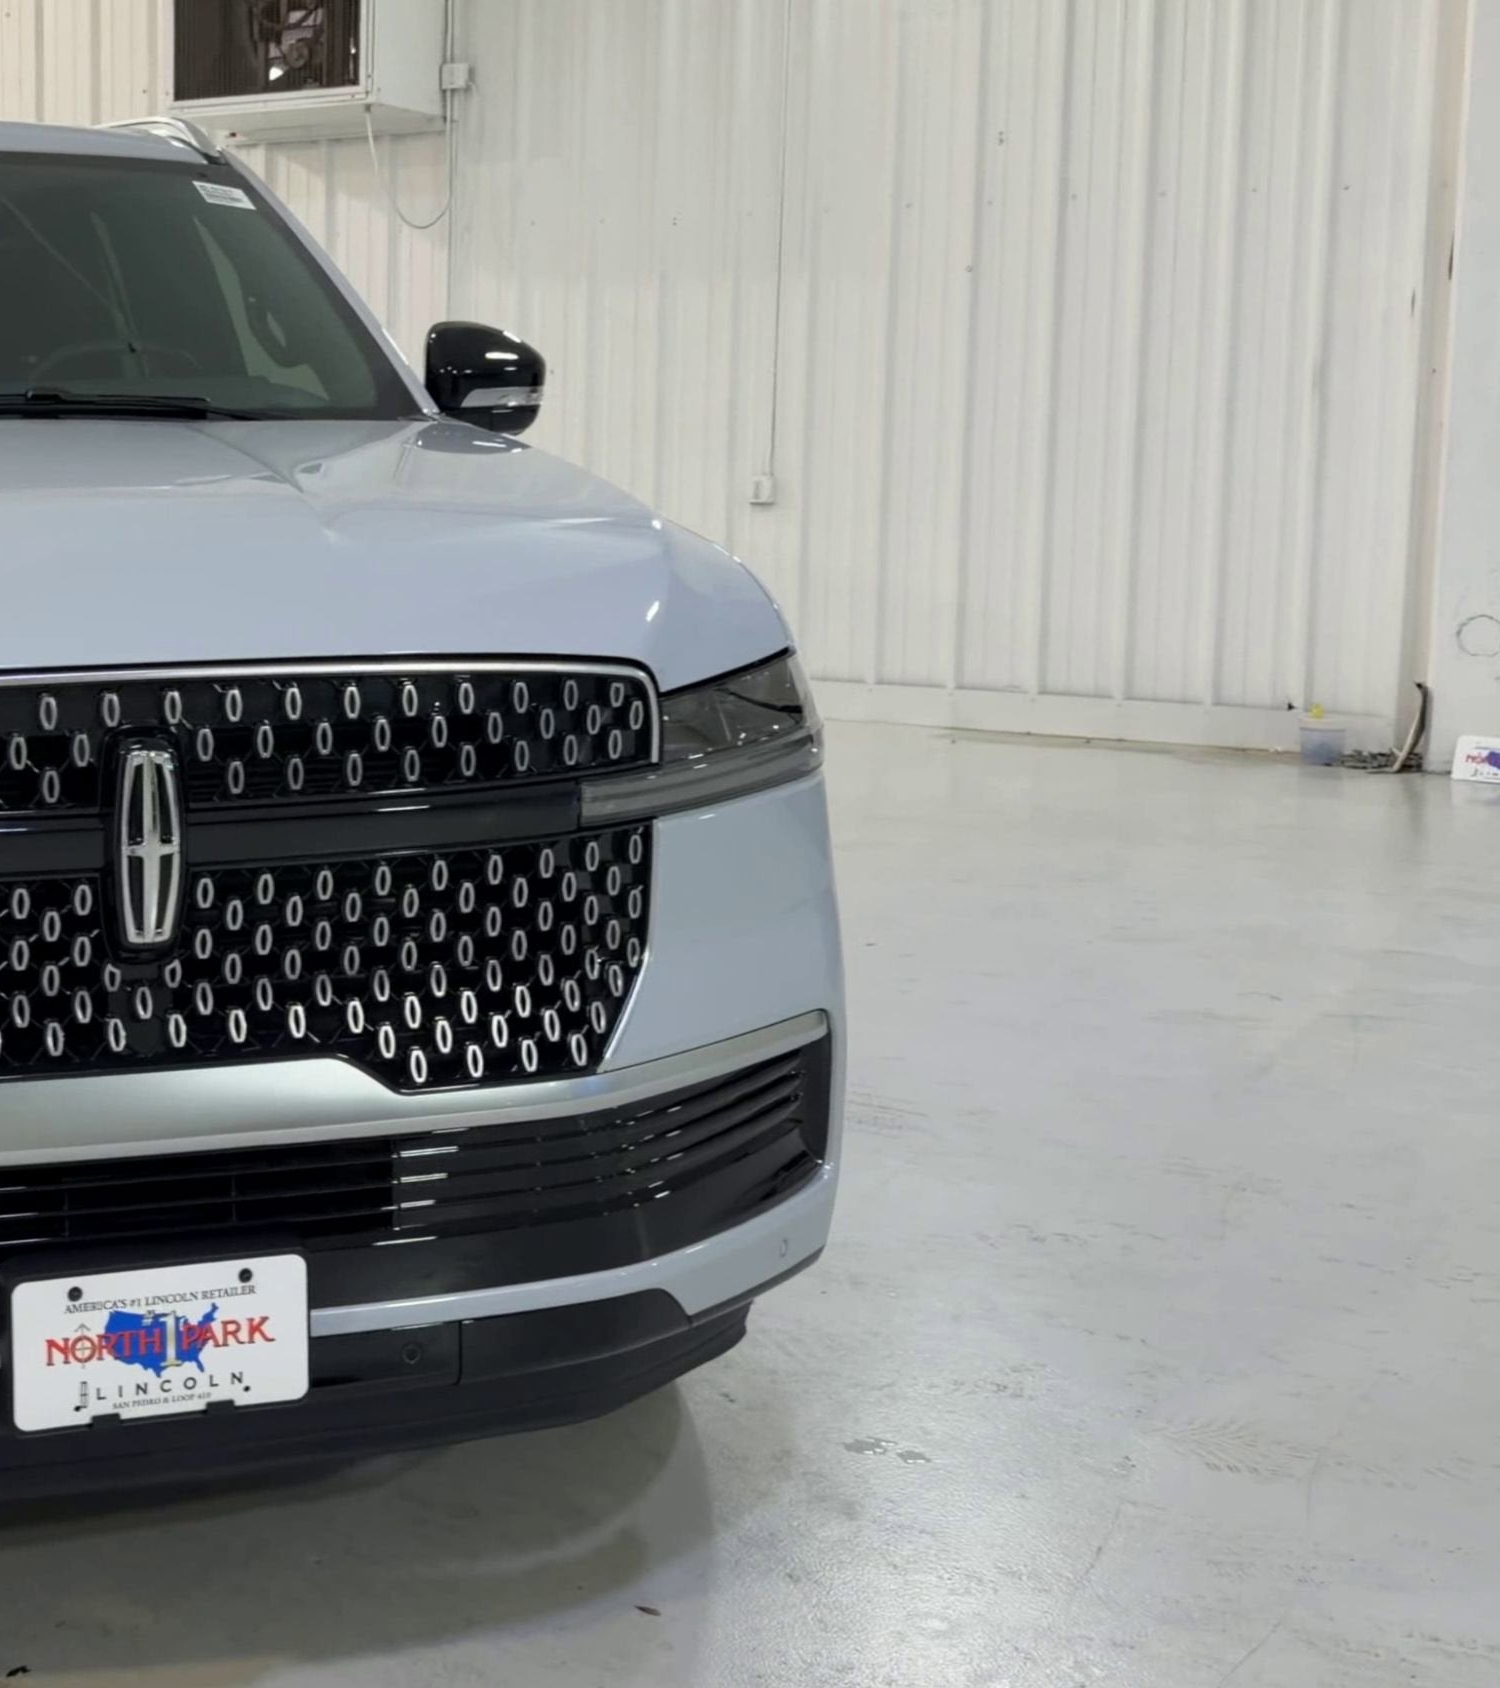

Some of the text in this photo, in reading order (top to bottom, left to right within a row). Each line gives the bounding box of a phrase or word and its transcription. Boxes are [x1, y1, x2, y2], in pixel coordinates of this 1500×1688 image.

[64, 1299, 127, 1314] AMERICA'S
[144, 1290, 199, 1307] LINCOLN
[201, 1284, 256, 1300] RETAILER
[45, 1328, 162, 1367] NORTH
[181, 1315, 276, 1350] PARK
[96, 1371, 244, 1401] LINCOLN
